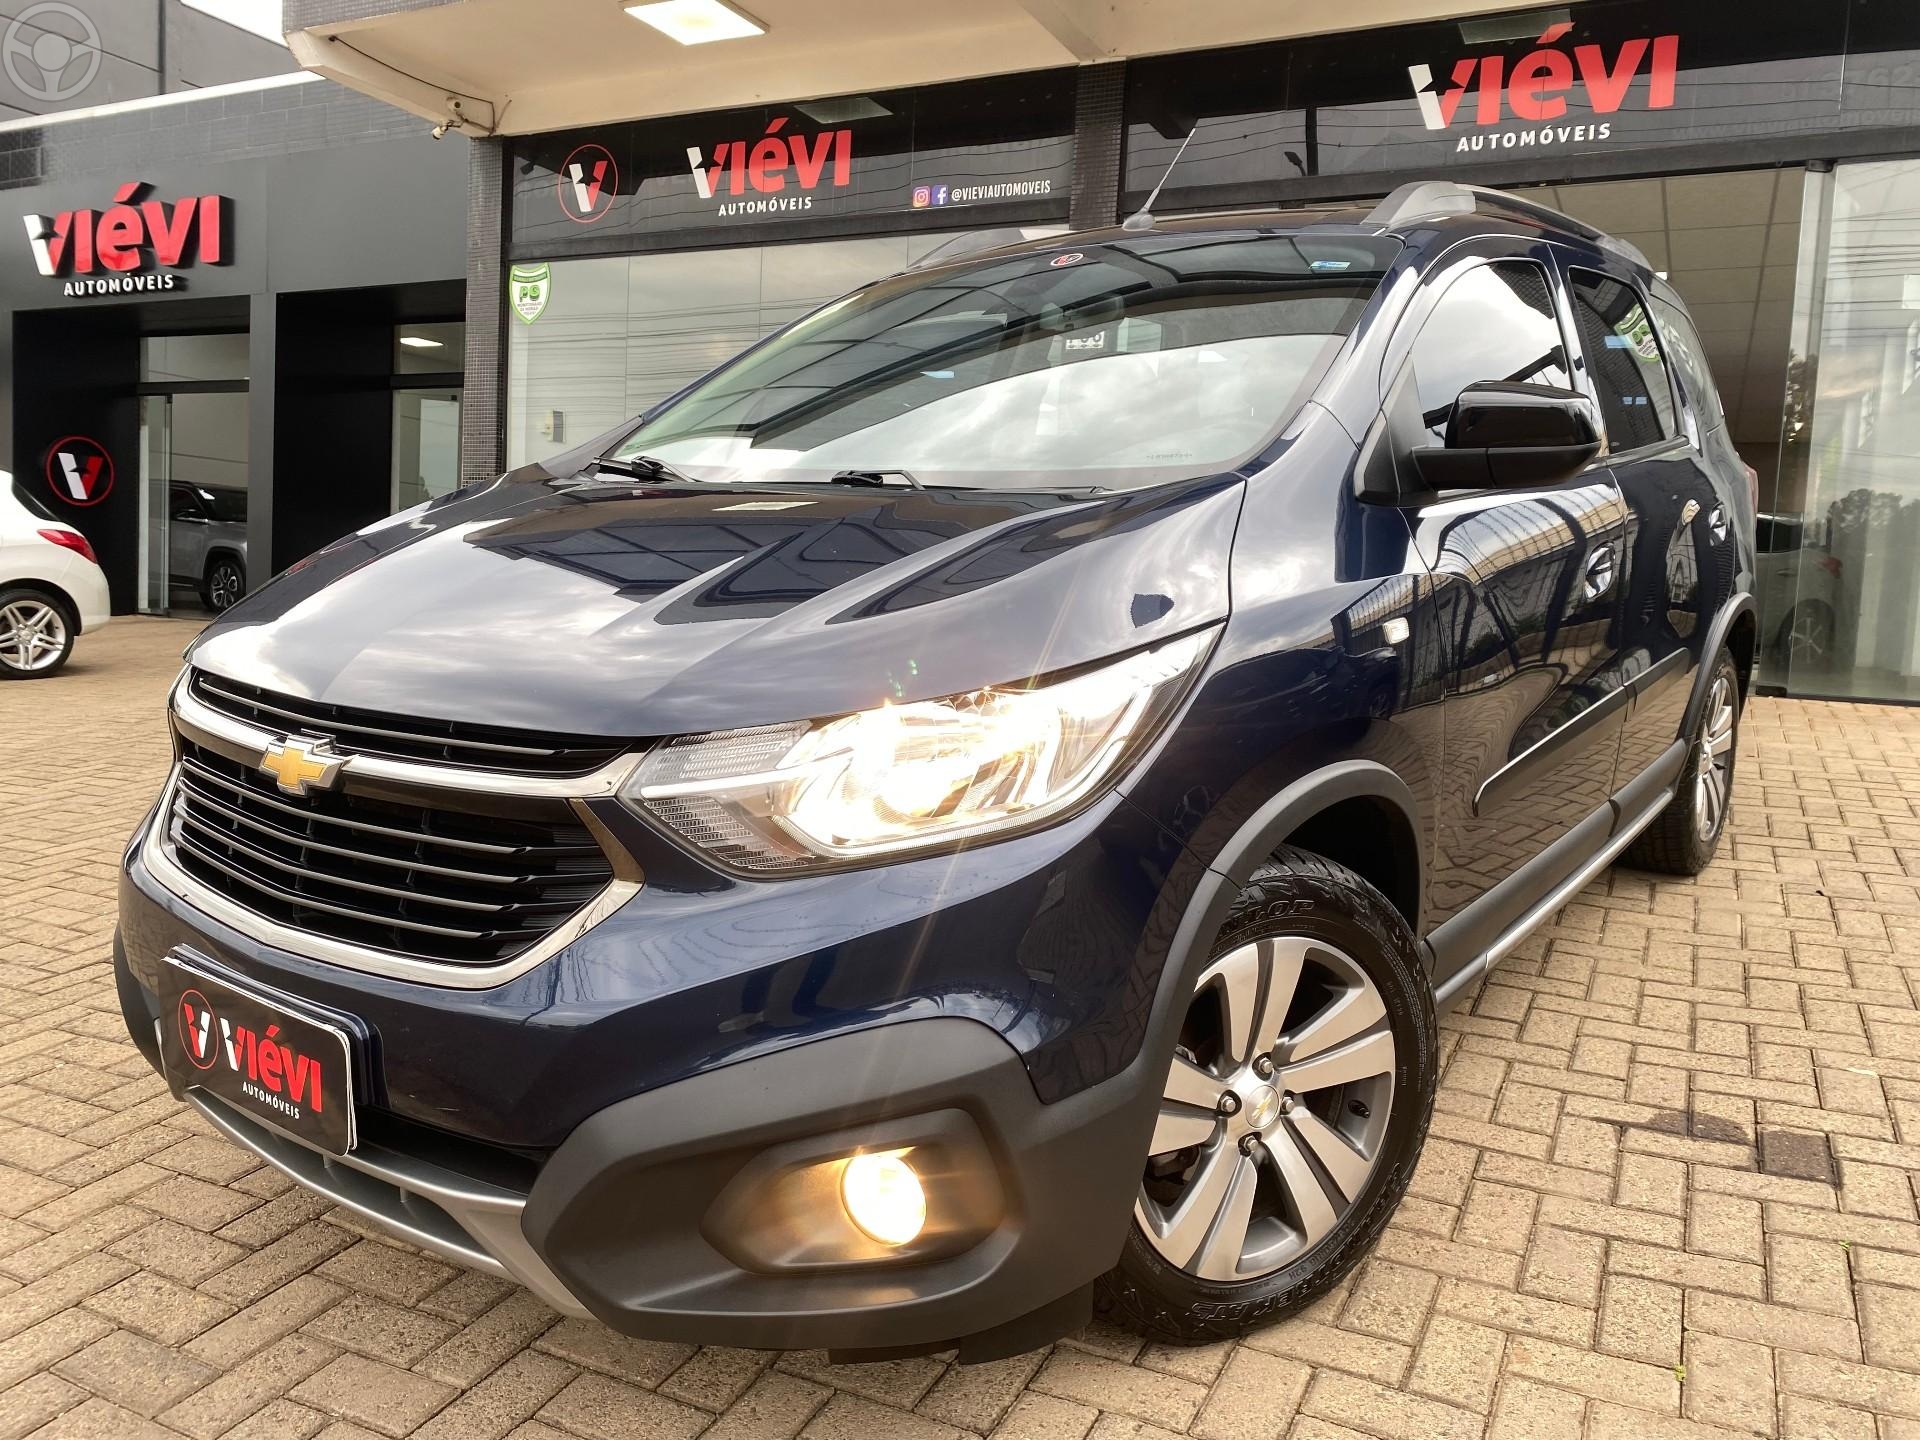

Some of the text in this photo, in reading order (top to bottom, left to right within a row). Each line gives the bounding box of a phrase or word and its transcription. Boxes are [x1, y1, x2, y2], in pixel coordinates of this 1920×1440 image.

[1456, 123, 1611, 152] AUTOMÓVEIS
[951, 180, 1051, 201] @VIEVIAUTOMOVEIS
[718, 196, 812, 216] AUTOMÓVEIS
[63, 273, 174, 296] AUTOMÓVEIS
[243, 1081, 300, 1119] AUTOMÓVEIS
